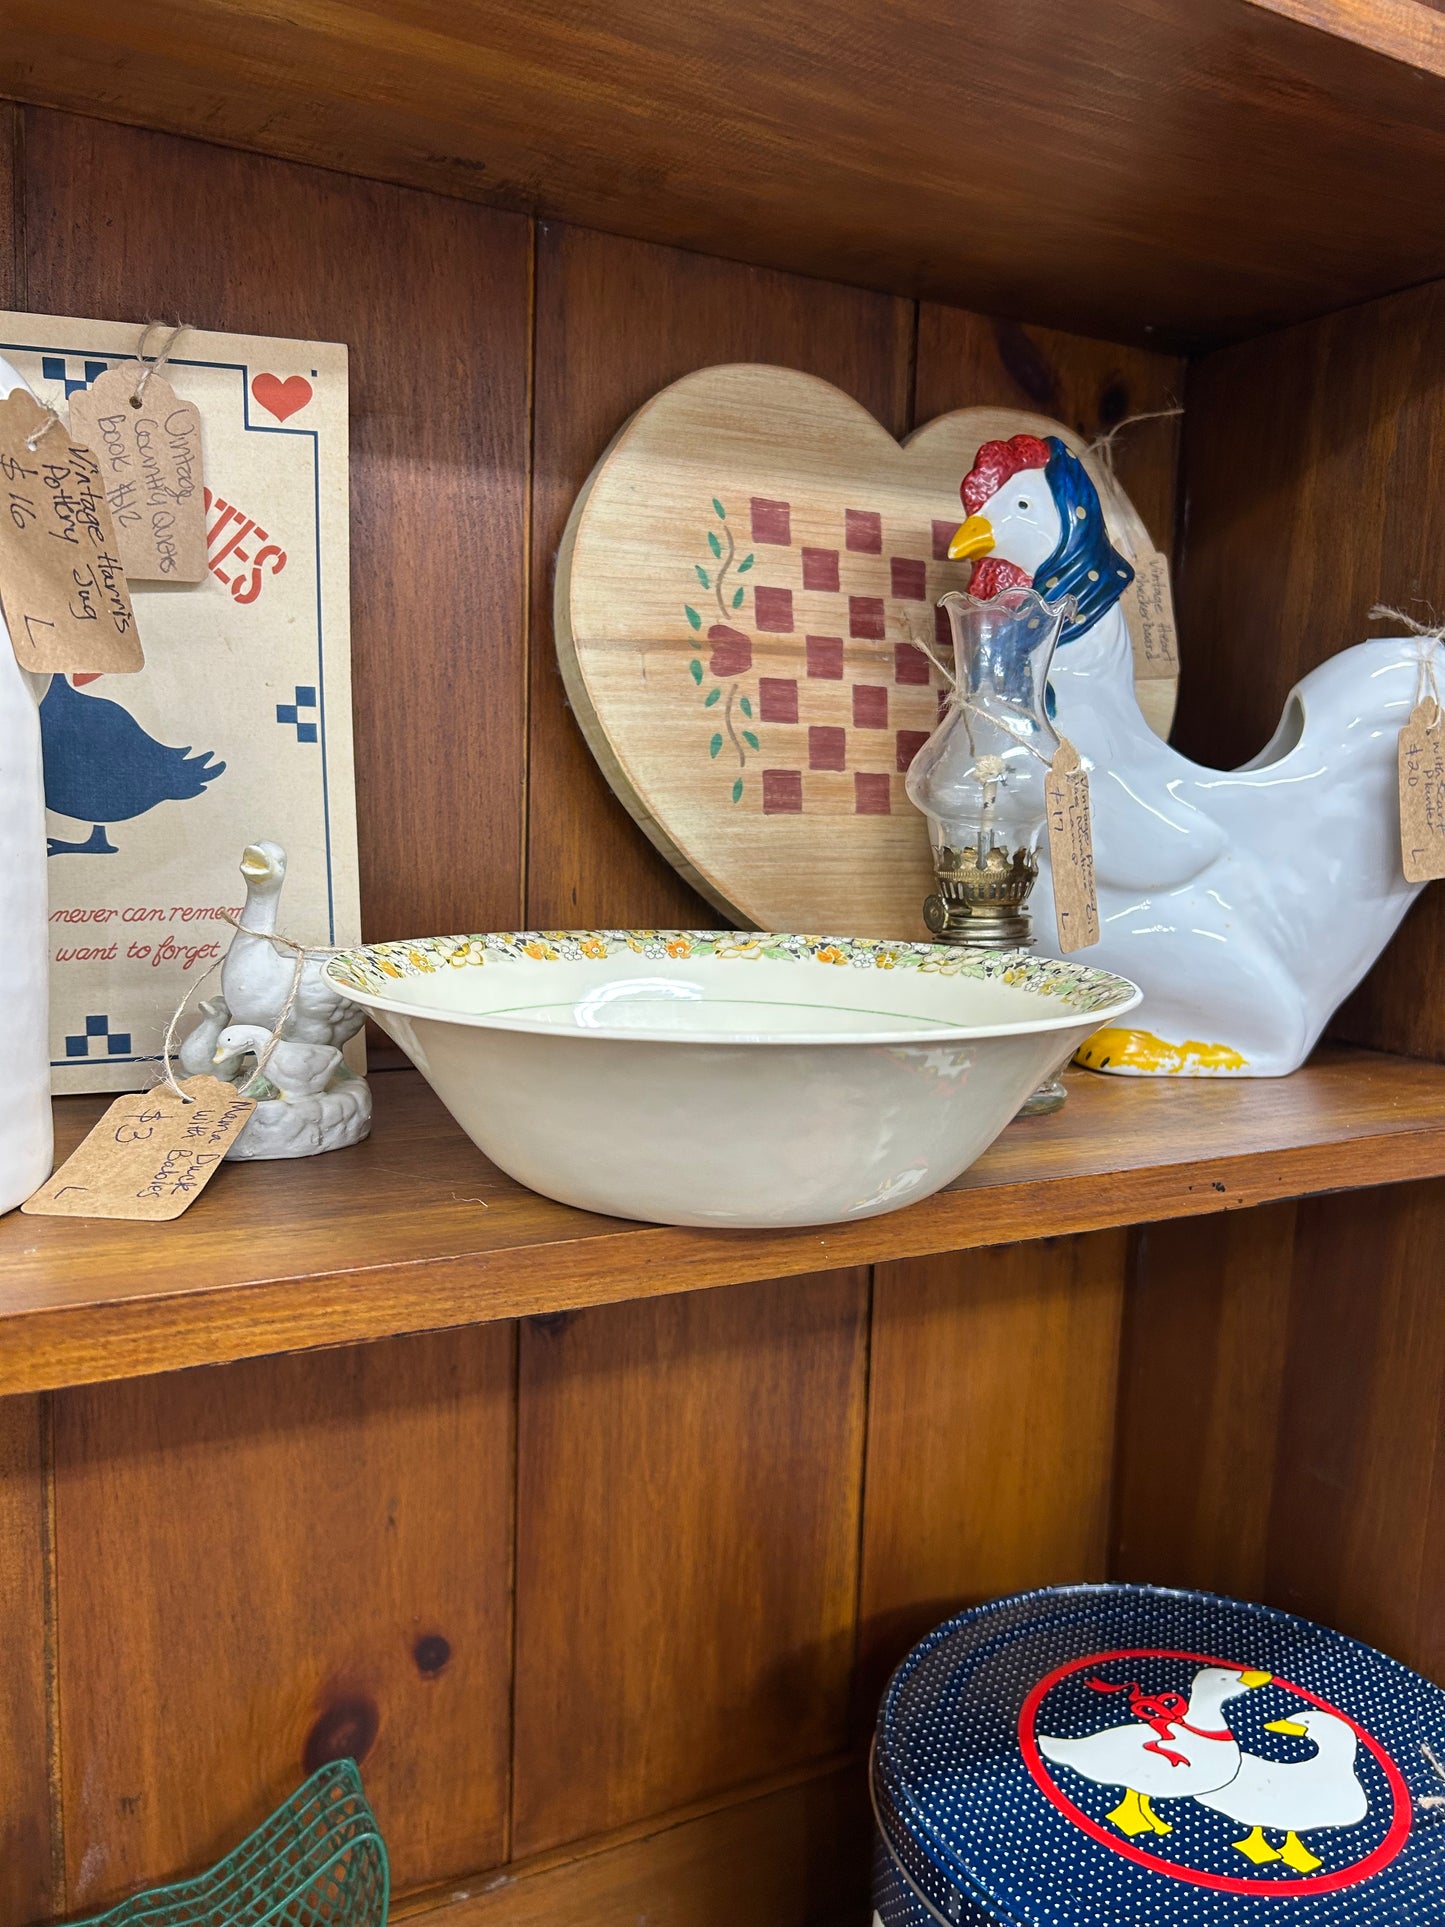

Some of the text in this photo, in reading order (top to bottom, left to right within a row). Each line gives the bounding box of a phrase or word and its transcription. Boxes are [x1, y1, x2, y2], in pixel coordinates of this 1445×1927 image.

[42, 464, 102, 620] Pottery Jug
[68, 447, 133, 634] Vintage Harris
[107, 480, 142, 528] $12
[204, 486, 287, 604] TES
[1149, 561, 1176, 664] Vintage Heart
[1080, 777, 1090, 846] Vintage
[48, 908, 118, 923] never
[122, 907, 166, 922] can
[56, 935, 221, 970] want to forget
[136, 1149, 193, 1198] Babies
[171, 1101, 253, 1195] Mama Duck
